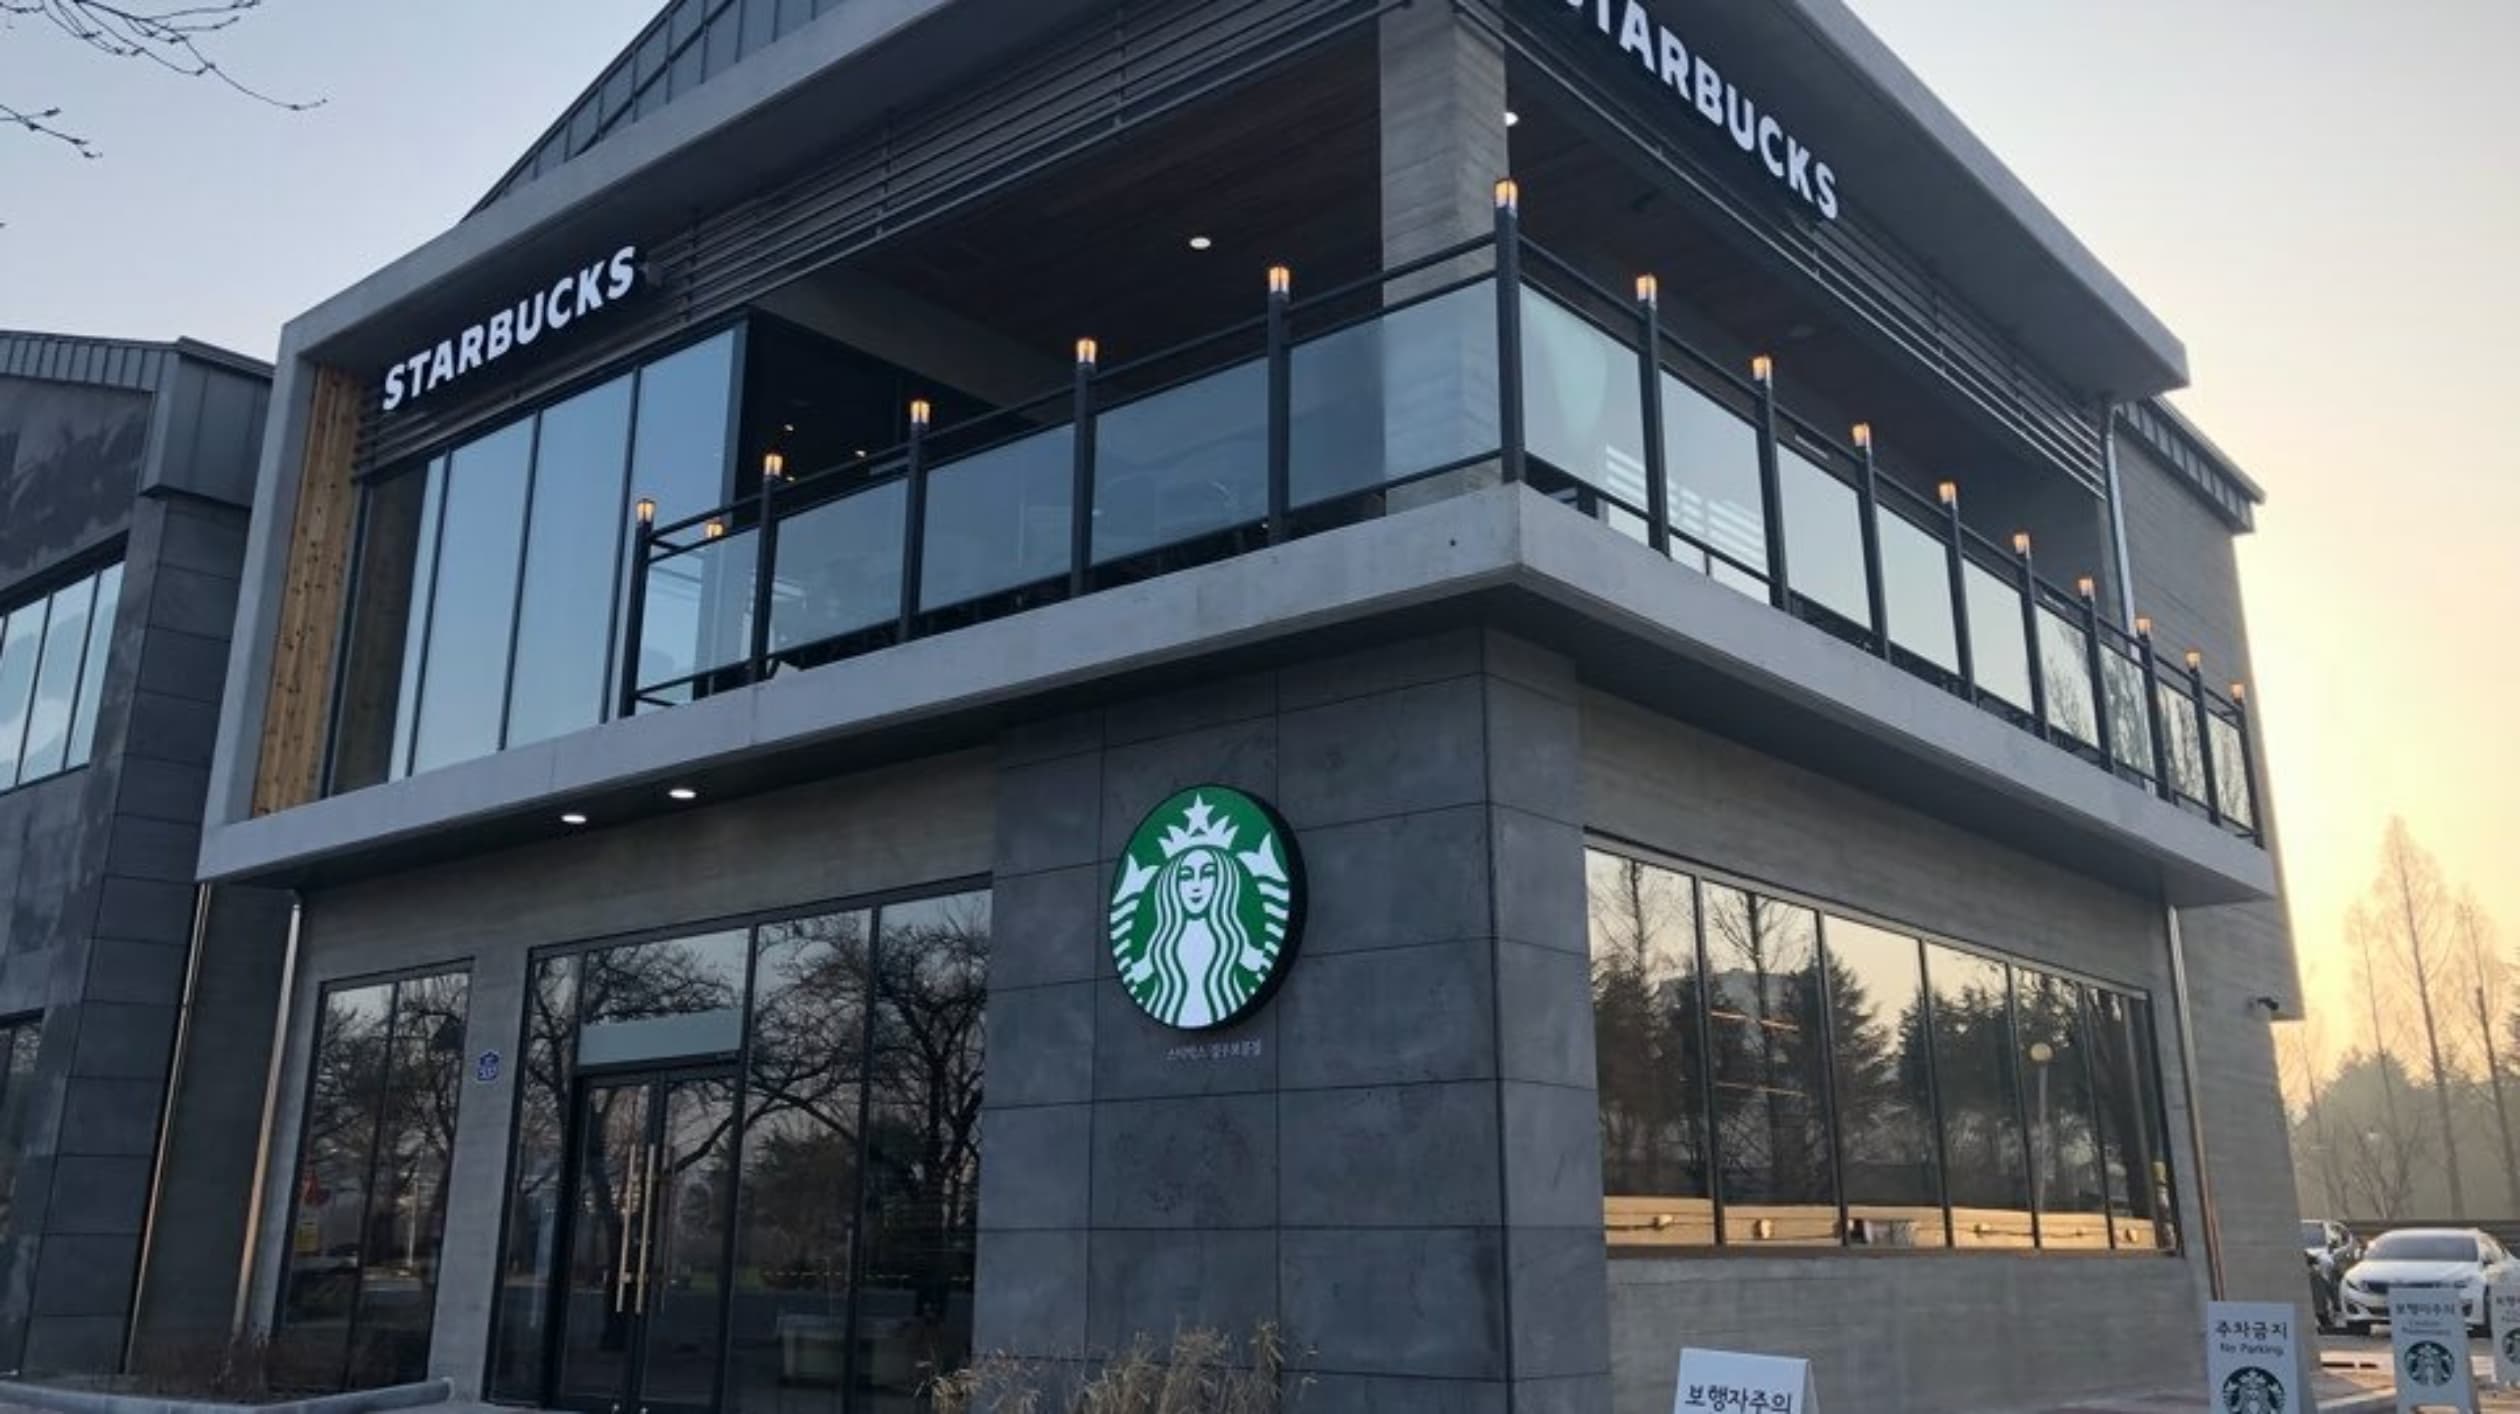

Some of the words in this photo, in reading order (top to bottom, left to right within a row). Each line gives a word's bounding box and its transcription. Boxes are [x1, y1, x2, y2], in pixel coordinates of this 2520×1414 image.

[382, 246, 636, 410] STARBUCKS
[2216, 1320, 2288, 1341] 주차금지
[1684, 1384, 1792, 1414] 보행자주의
